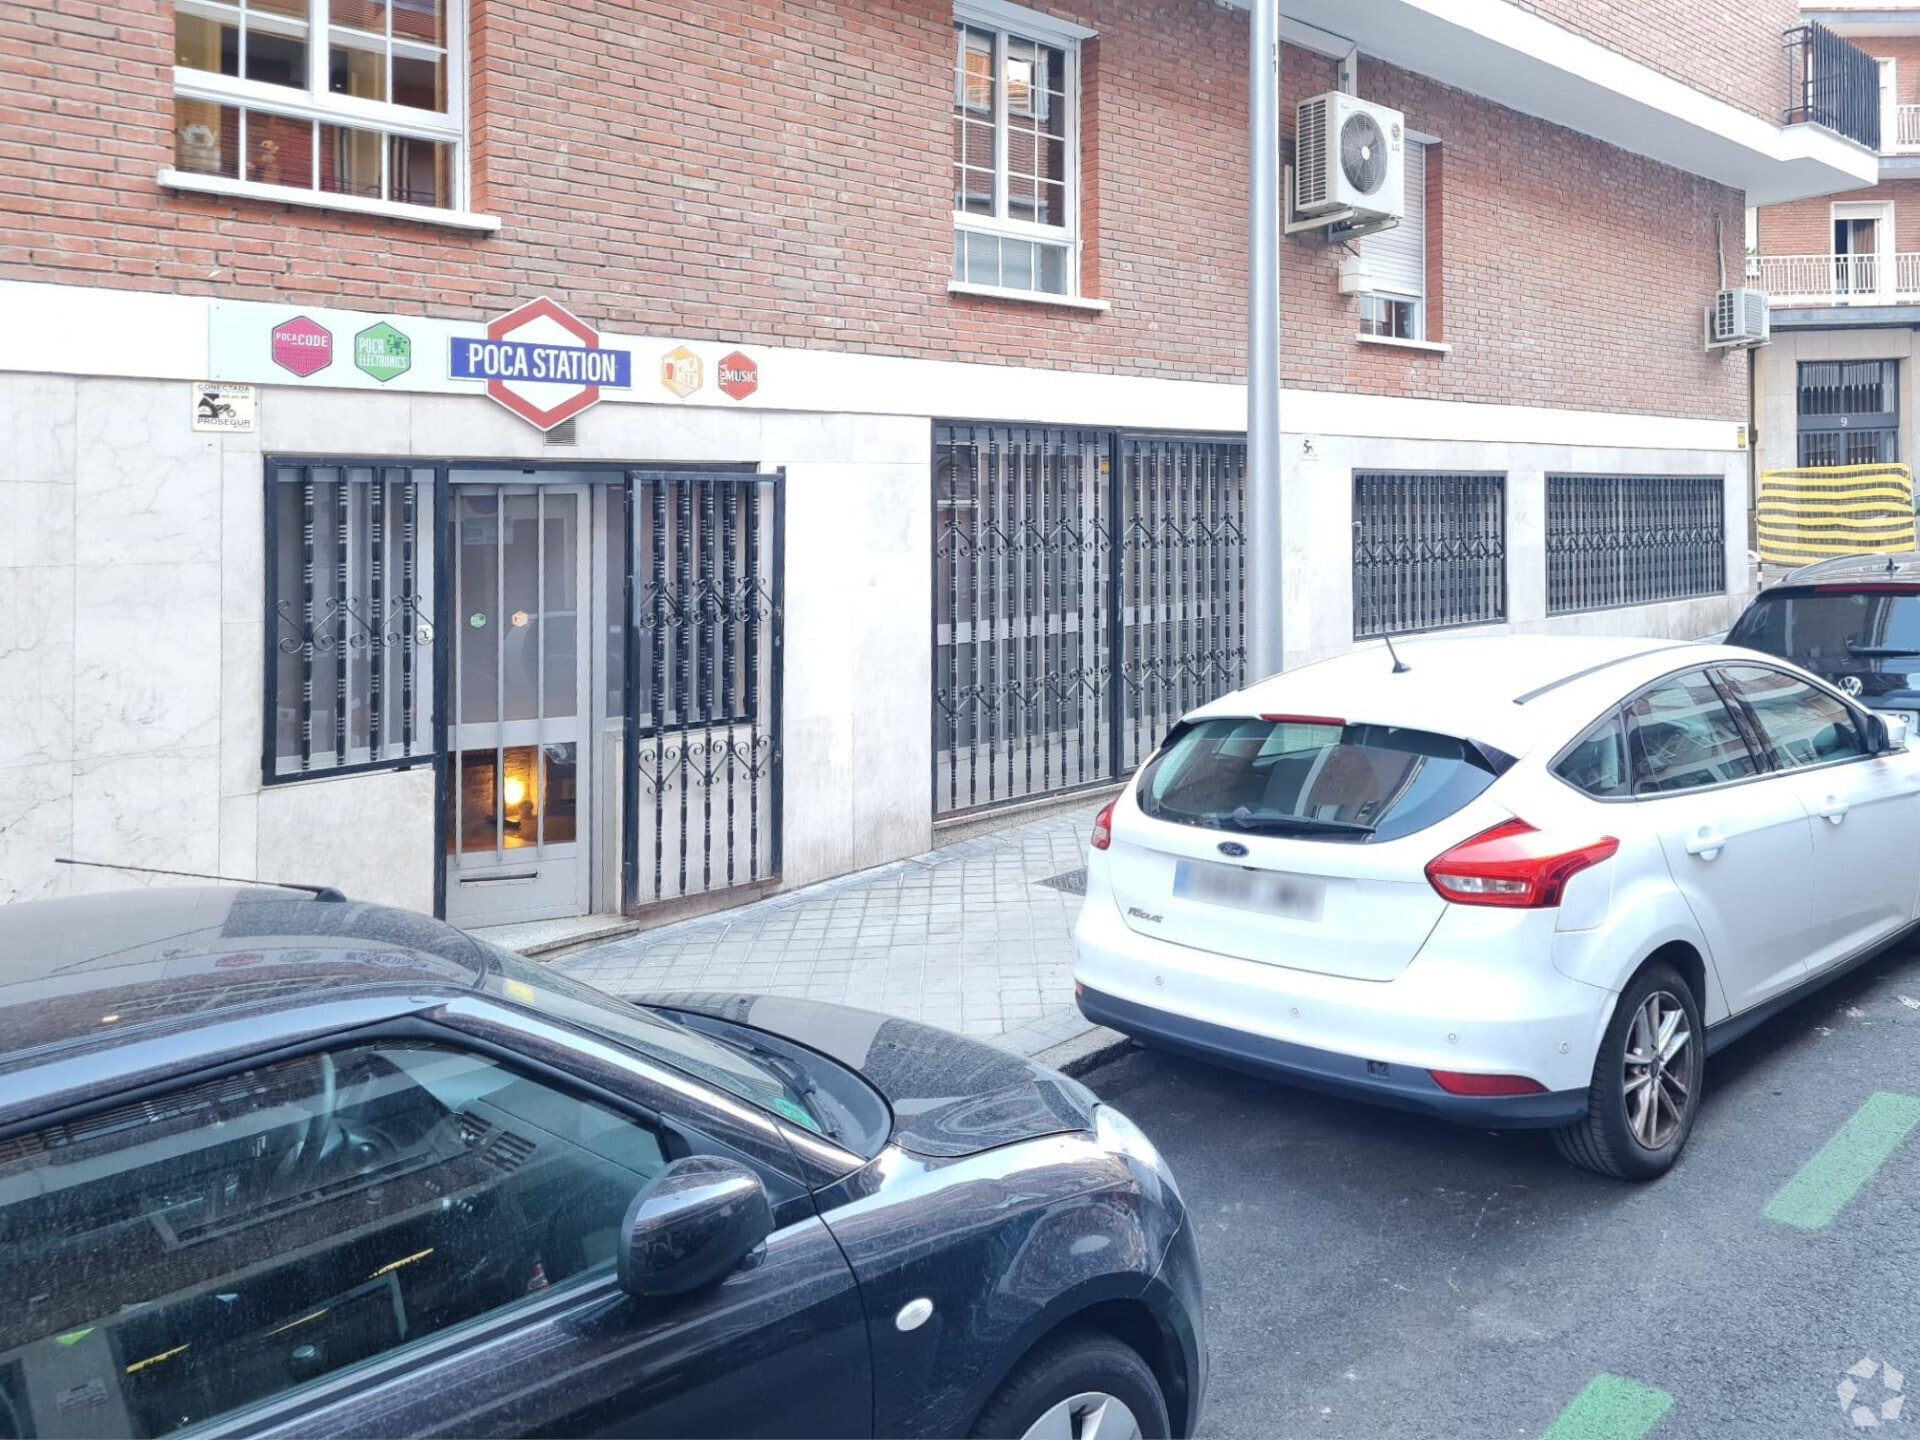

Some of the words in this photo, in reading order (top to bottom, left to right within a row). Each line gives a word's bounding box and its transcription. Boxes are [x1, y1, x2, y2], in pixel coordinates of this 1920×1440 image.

[359, 337, 384, 354] POCA
[468, 343, 528, 378] POCA
[532, 348, 616, 383] STATION
[727, 370, 757, 383] MUSIC
[197, 417, 251, 426] PROSEGUR
[1840, 416, 1848, 427] 9
